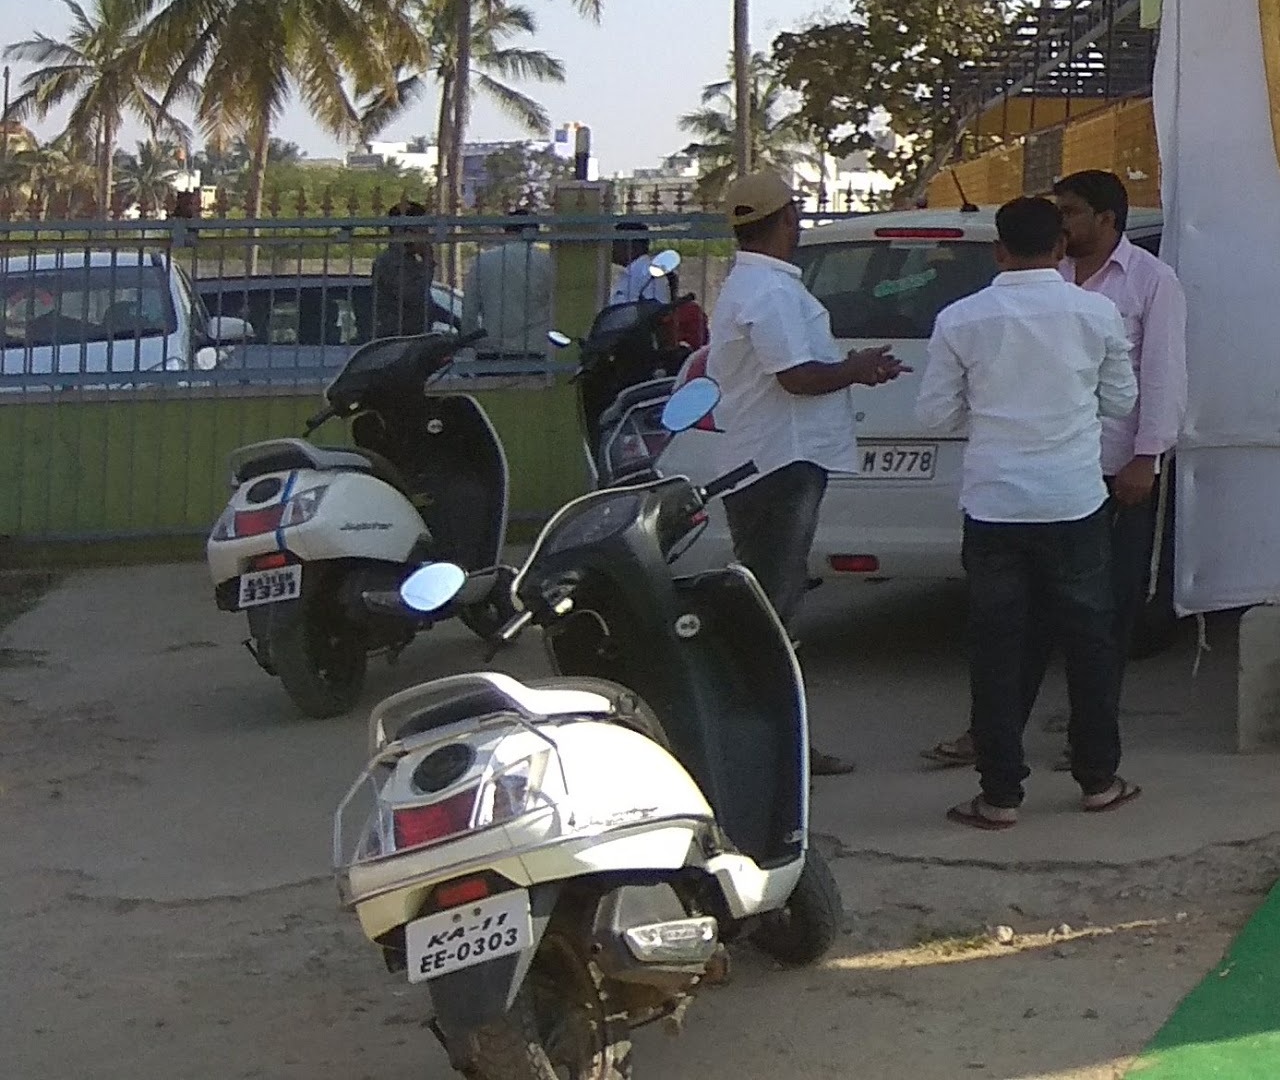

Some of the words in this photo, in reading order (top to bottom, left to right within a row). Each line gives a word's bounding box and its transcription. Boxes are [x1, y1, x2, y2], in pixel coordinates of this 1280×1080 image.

[880, 451, 932, 472] 9778
[243, 580, 296, 603] 3331
[427, 912, 509, 949] KA-11
[420, 928, 518, 974] EE-0303
